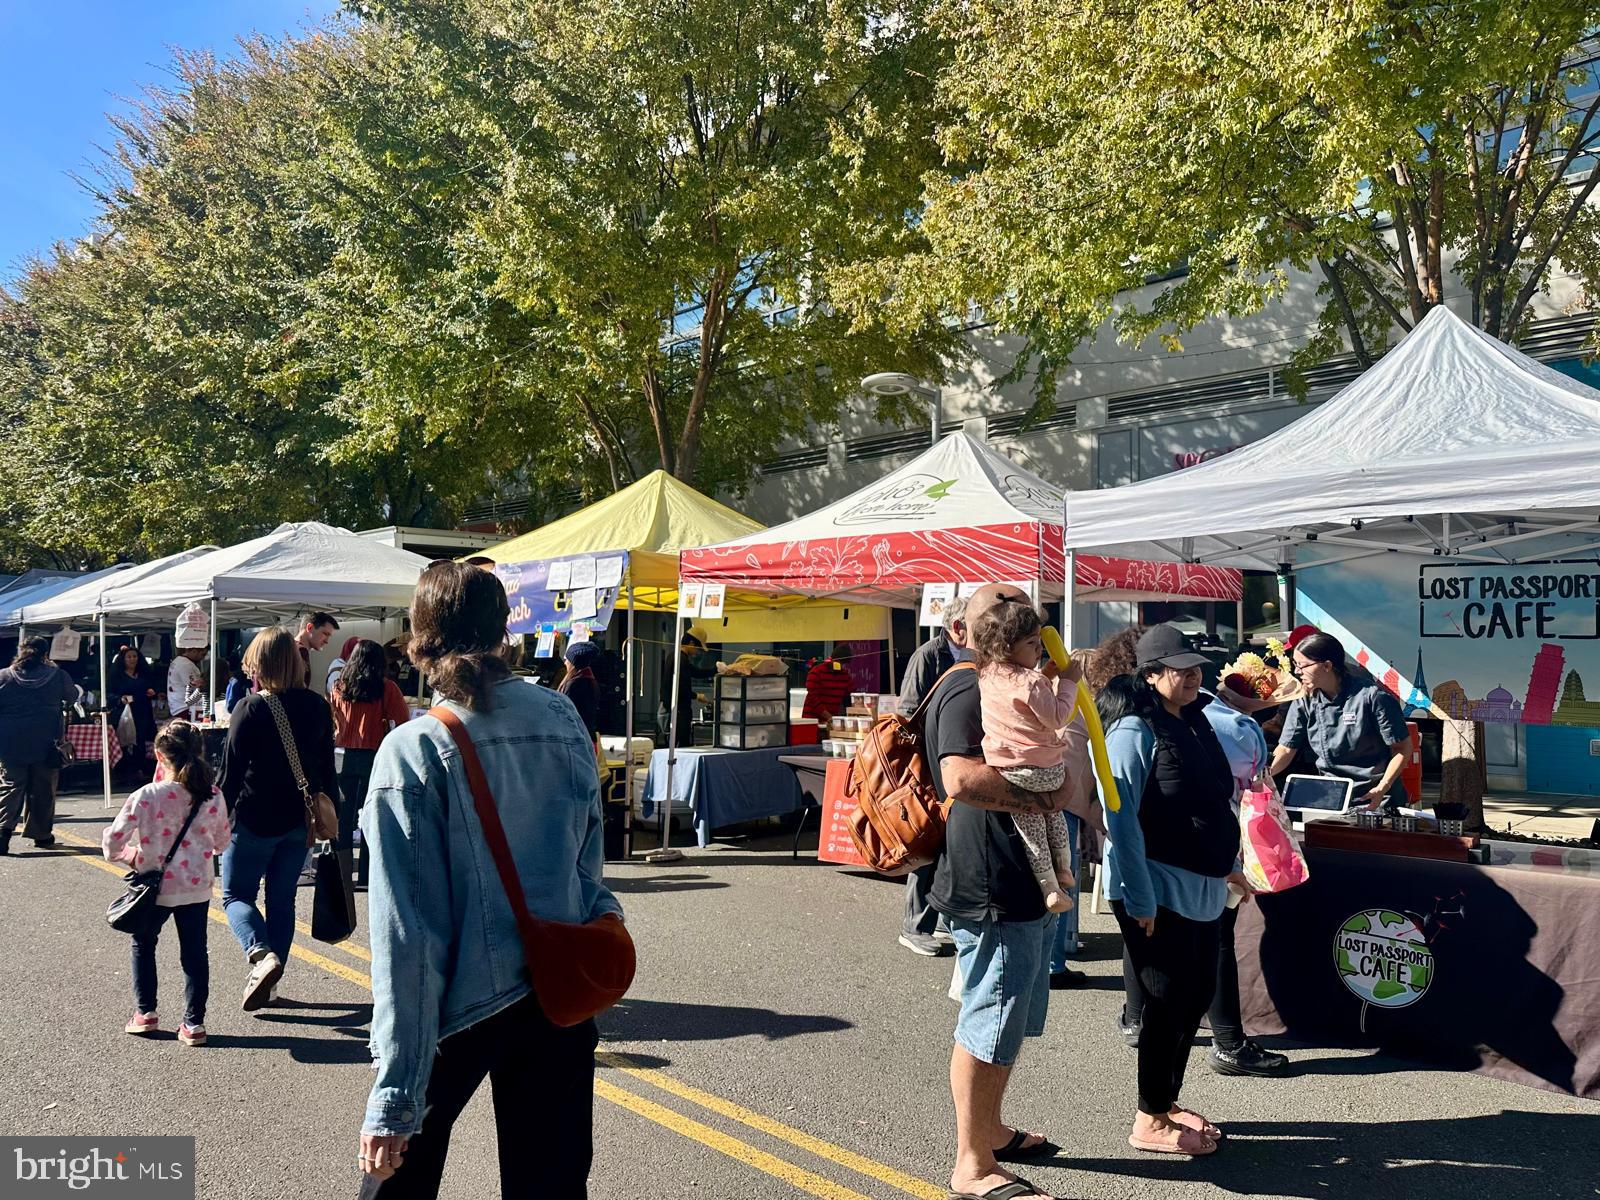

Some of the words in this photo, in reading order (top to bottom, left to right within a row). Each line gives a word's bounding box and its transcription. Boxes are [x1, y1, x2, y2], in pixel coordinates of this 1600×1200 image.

[1418, 576, 1475, 600] LOST
[1479, 574, 1600, 600] PASSPORT
[1463, 601, 1557, 639] CAFE
[1338, 935, 1369, 954] LOST
[1370, 943, 1433, 967] PASSPORT
[1360, 956, 1408, 984] CAFE
